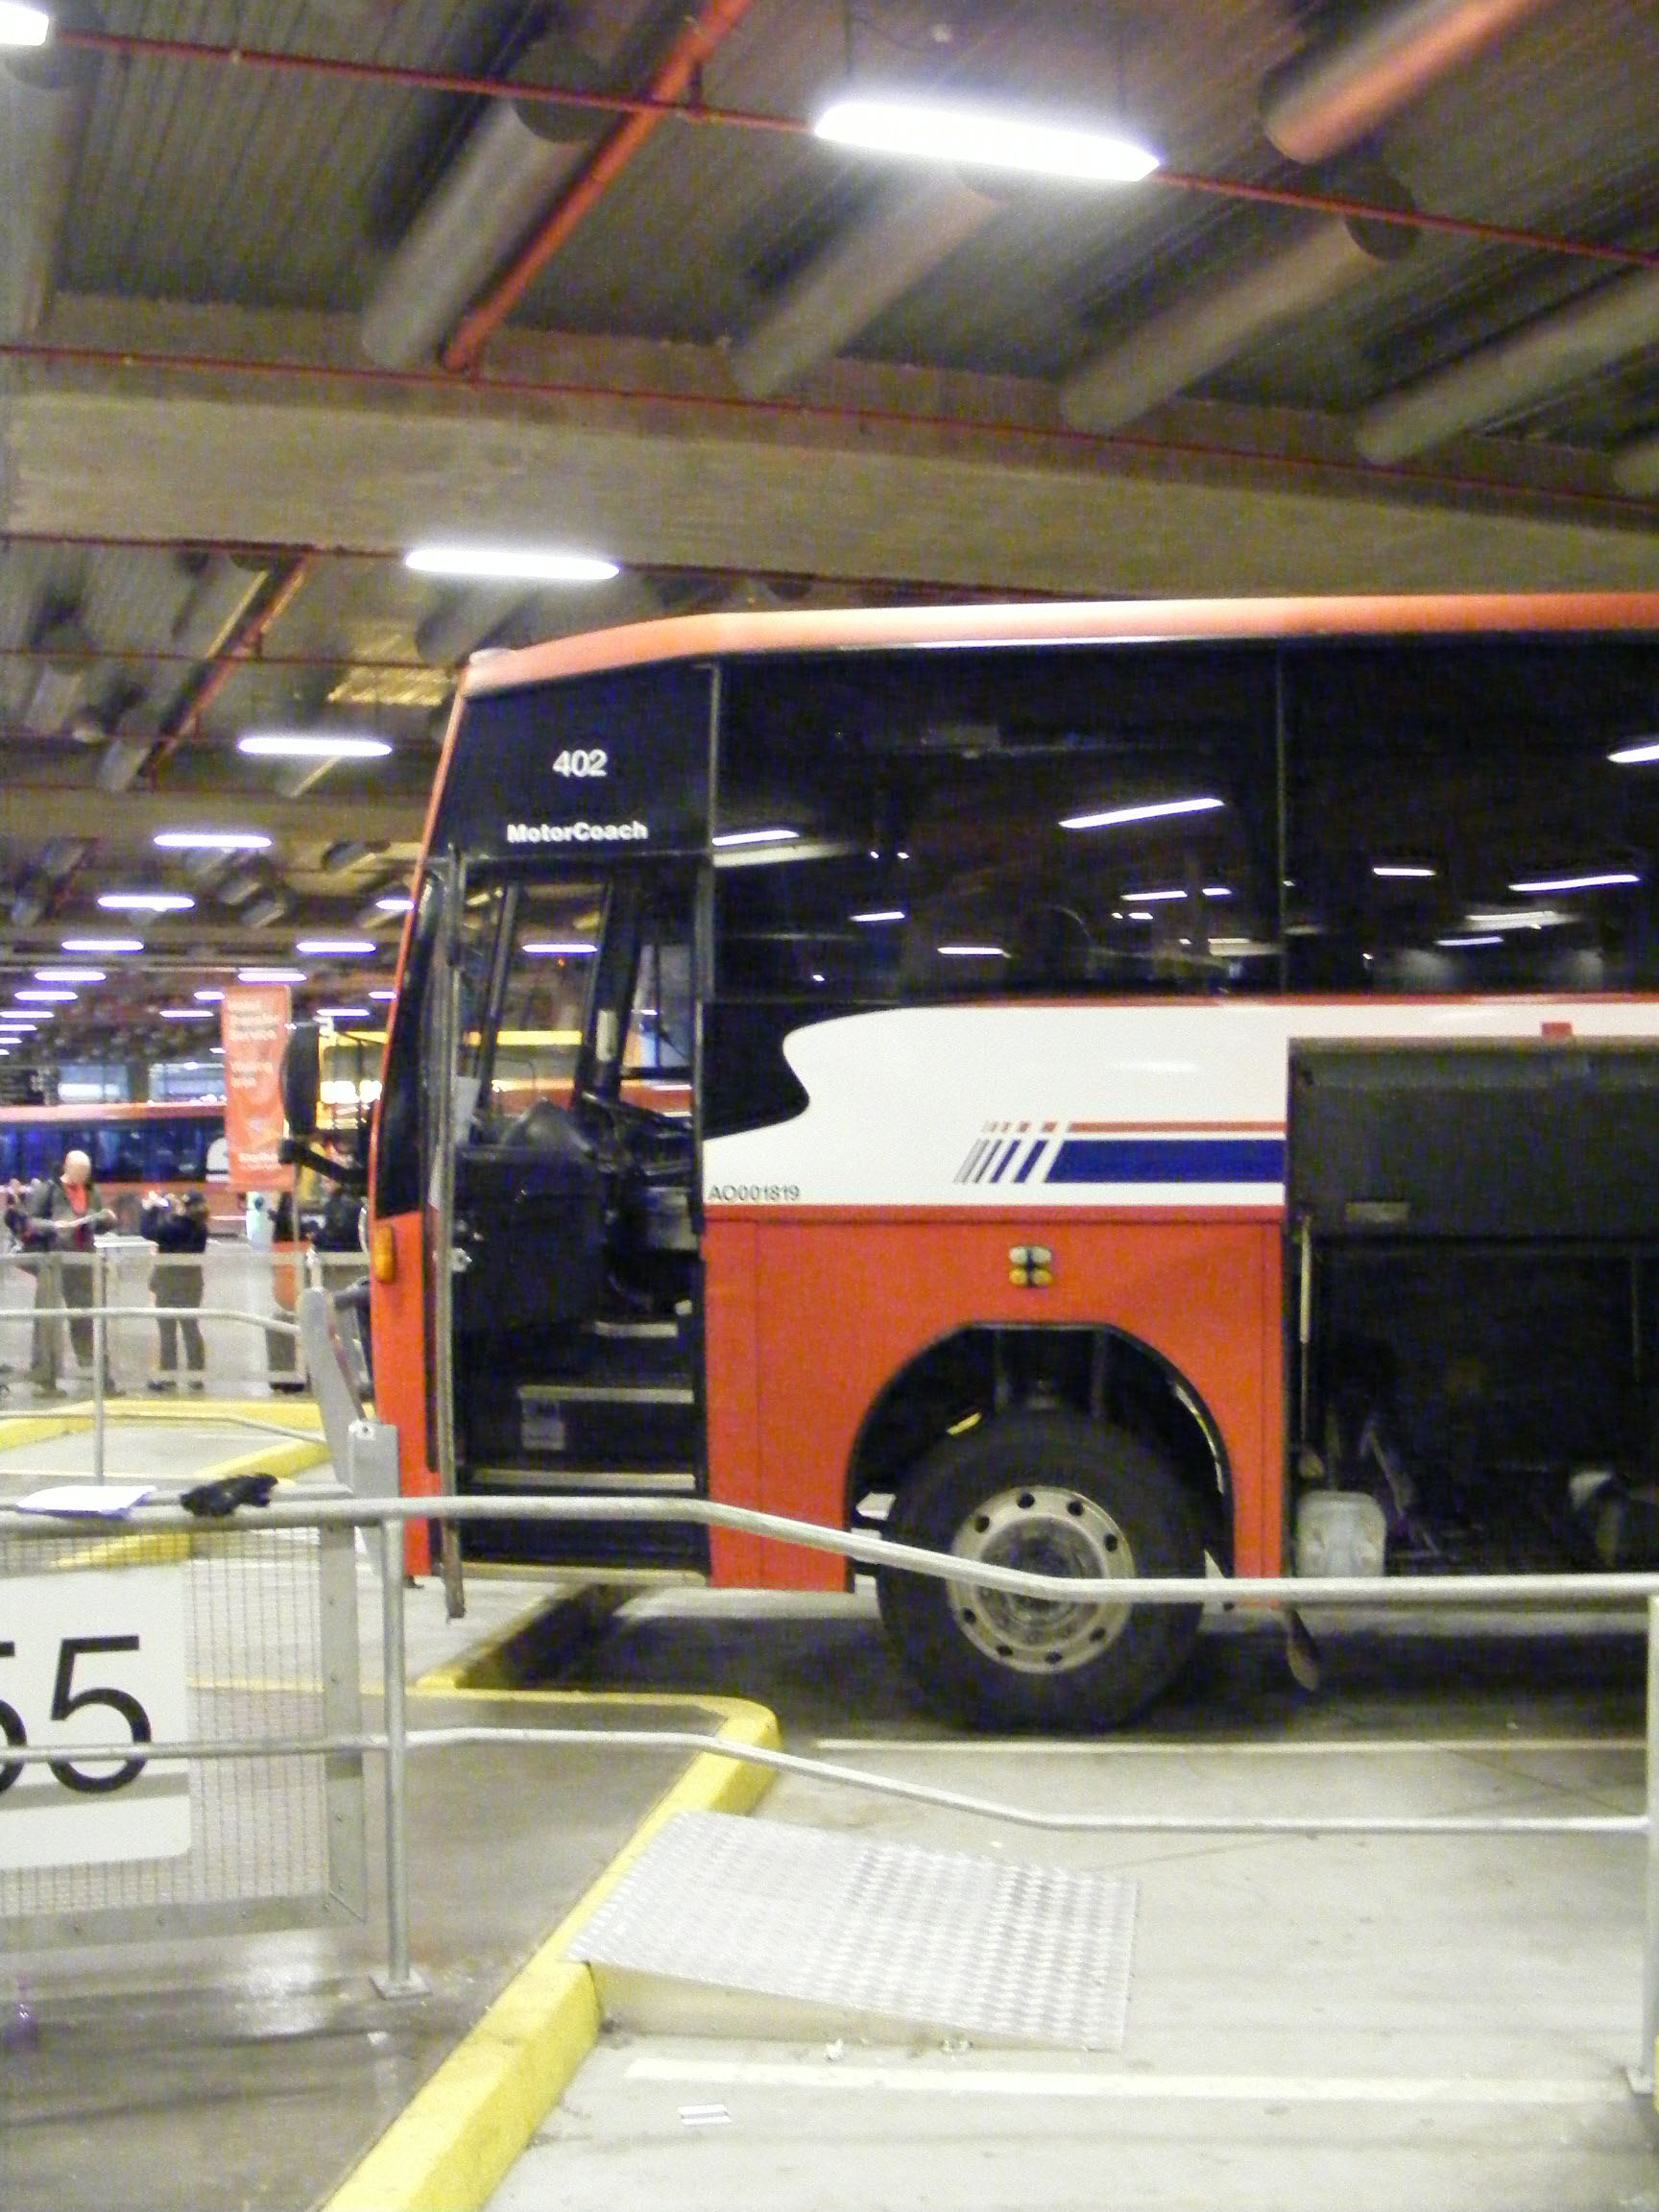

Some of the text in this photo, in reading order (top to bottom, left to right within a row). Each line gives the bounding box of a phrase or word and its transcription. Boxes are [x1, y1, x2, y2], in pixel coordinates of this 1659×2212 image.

[552, 749, 609, 778] 402
[507, 820, 649, 844] MotorCoach
[0, 1635, 152, 1793] 5
